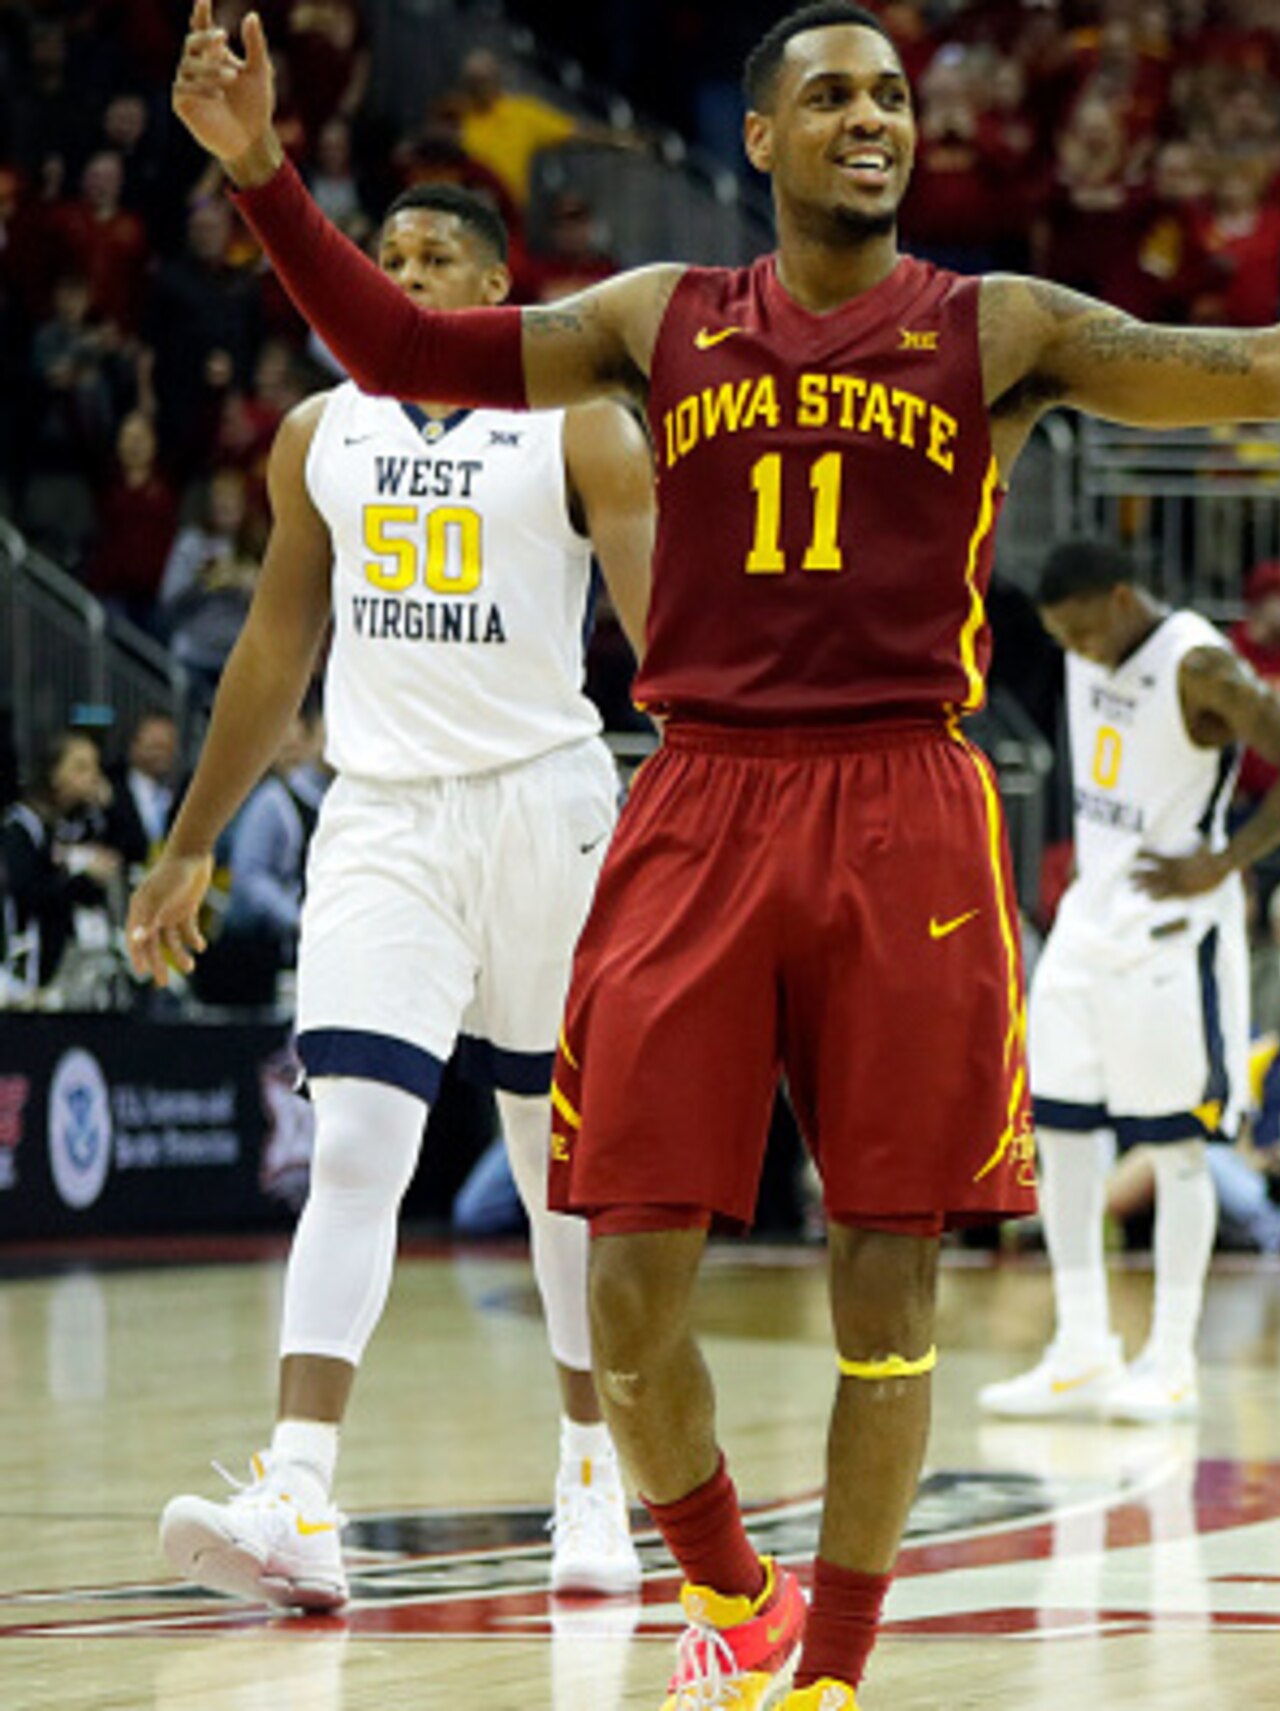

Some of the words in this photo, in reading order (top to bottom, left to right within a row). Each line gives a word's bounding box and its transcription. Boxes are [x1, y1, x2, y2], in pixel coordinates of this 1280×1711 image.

[663, 374, 780, 469] IOWA
[797, 374, 958, 475] STATE
[375, 456, 483, 497] WEST
[745, 452, 842, 574] 11
[362, 504, 484, 595] 50
[352, 597, 507, 643] VIRGINIA
[1091, 725, 1123, 790] 0
